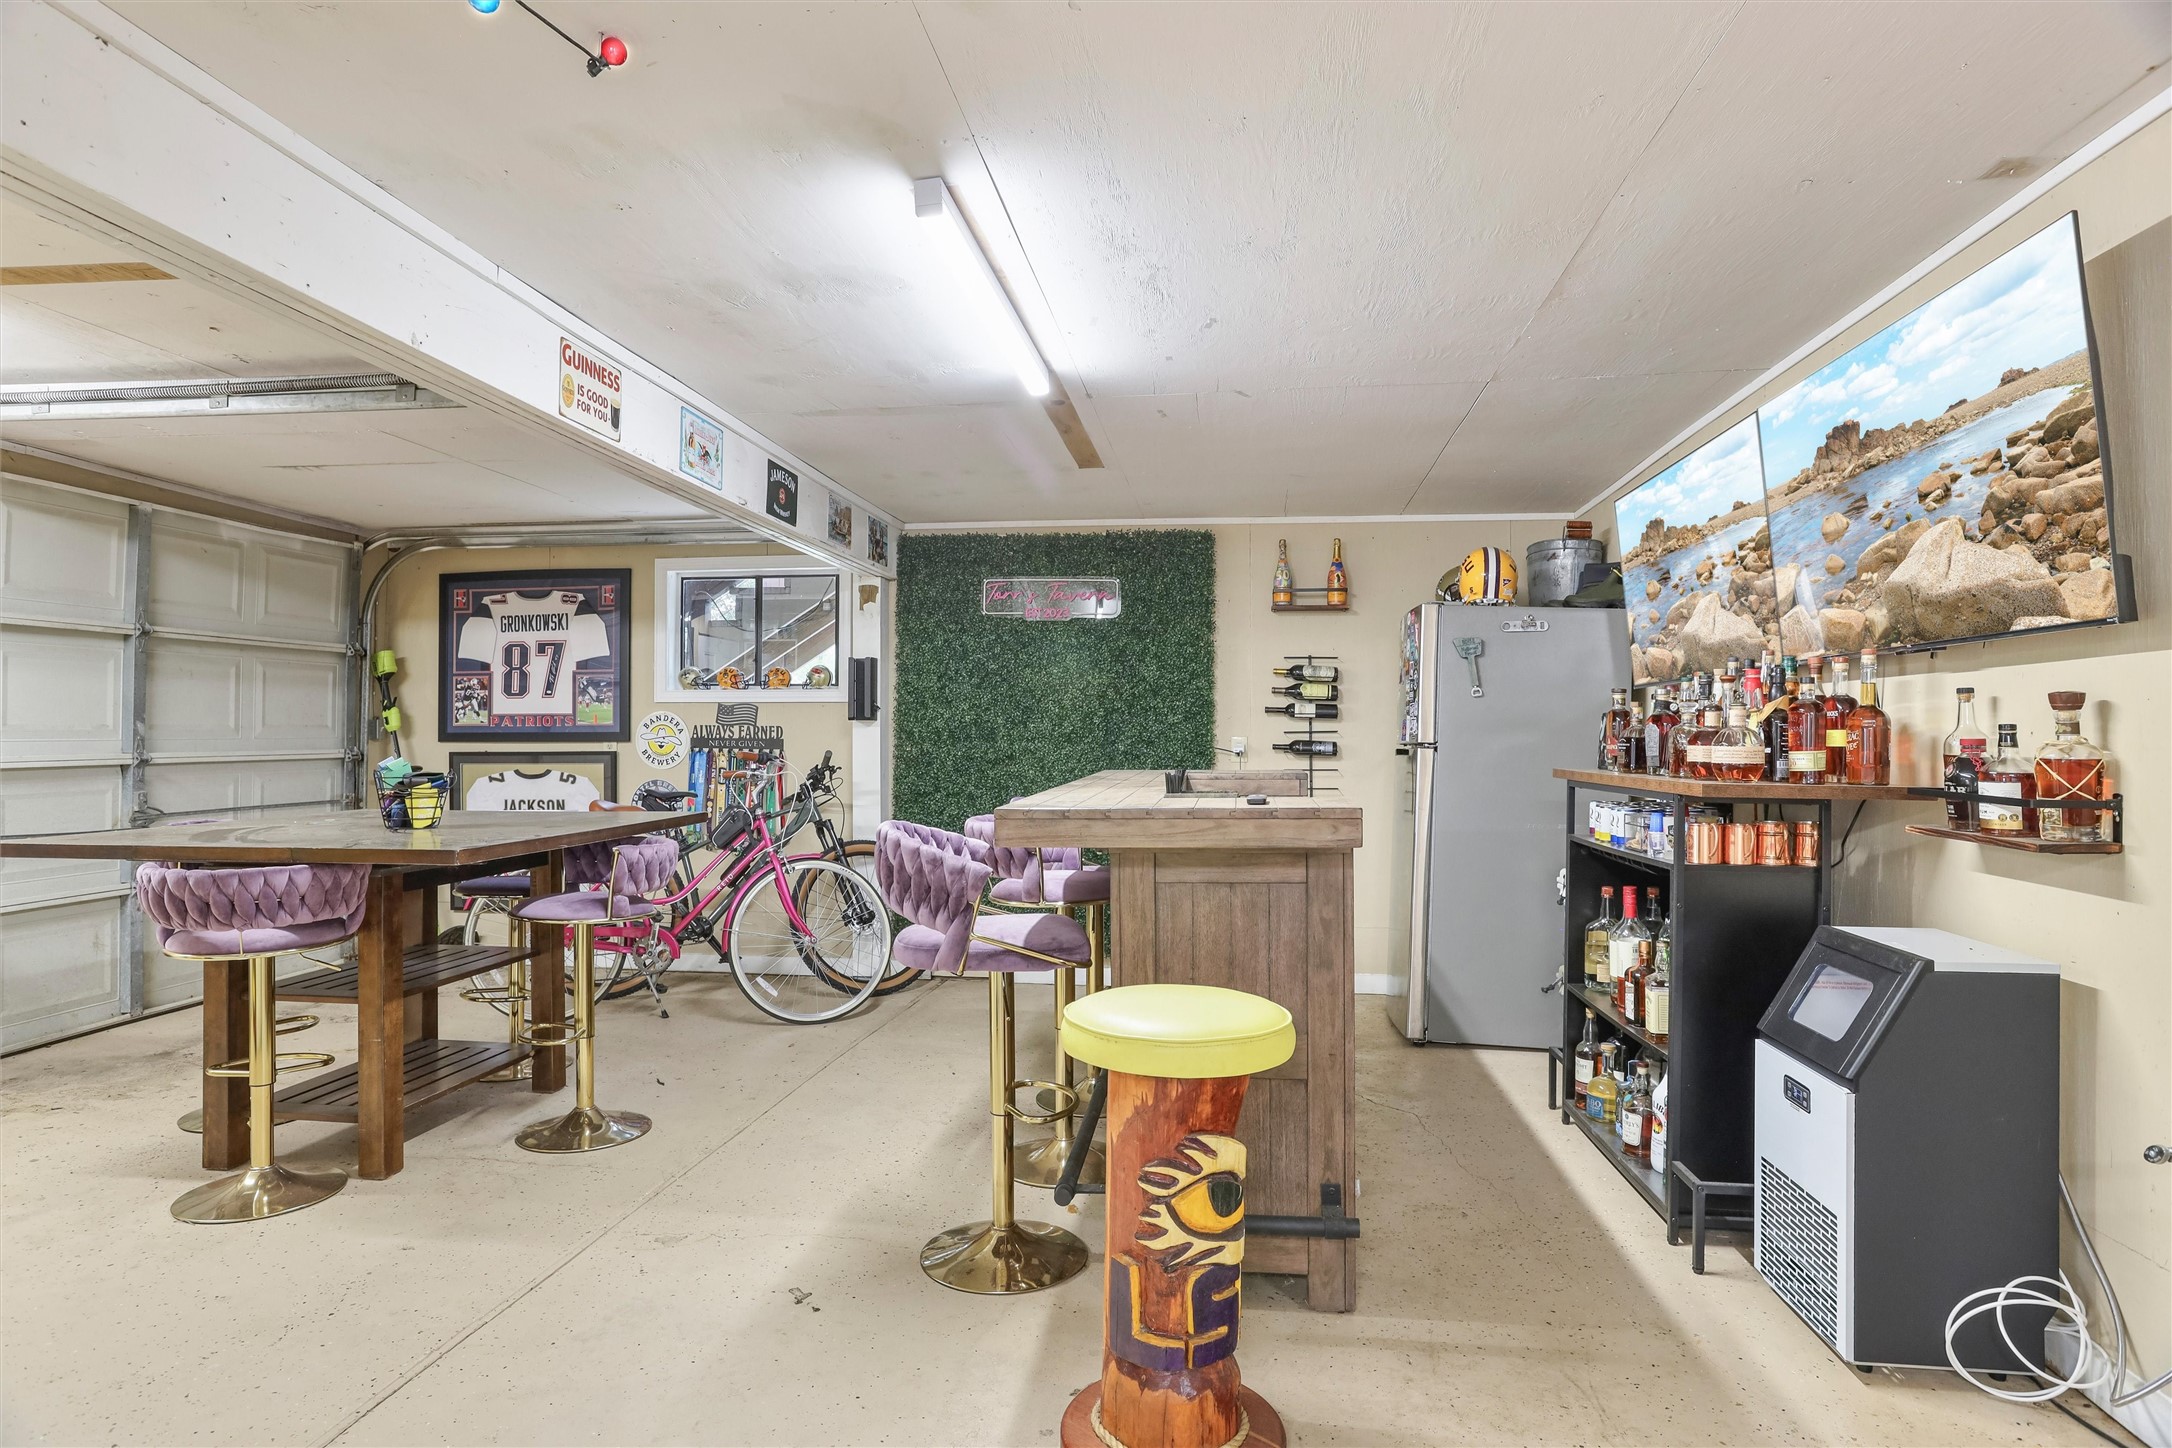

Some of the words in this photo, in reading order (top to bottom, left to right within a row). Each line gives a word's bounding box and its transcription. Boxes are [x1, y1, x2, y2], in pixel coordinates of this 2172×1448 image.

[562, 343, 620, 393] GUINNESS
[577, 383, 585, 397] IS
[587, 389, 609, 408] GOOD
[576, 399, 592, 415] FOR
[770, 469, 796, 493] JAMESON
[501, 612, 570, 633] GRONKOWSKI
[501, 639, 567, 700] 87
[489, 715, 576, 728] PATRIOTS
[643, 714, 685, 734] BANDERA
[692, 724, 735, 739] ALWAYS
[740, 725, 784, 739] EARNED
[708, 740, 736, 748] NEVER
[738, 740, 766, 748] GIVEN
[641, 749, 681, 766] BREWERY
[503, 799, 566, 810] JACKSON
